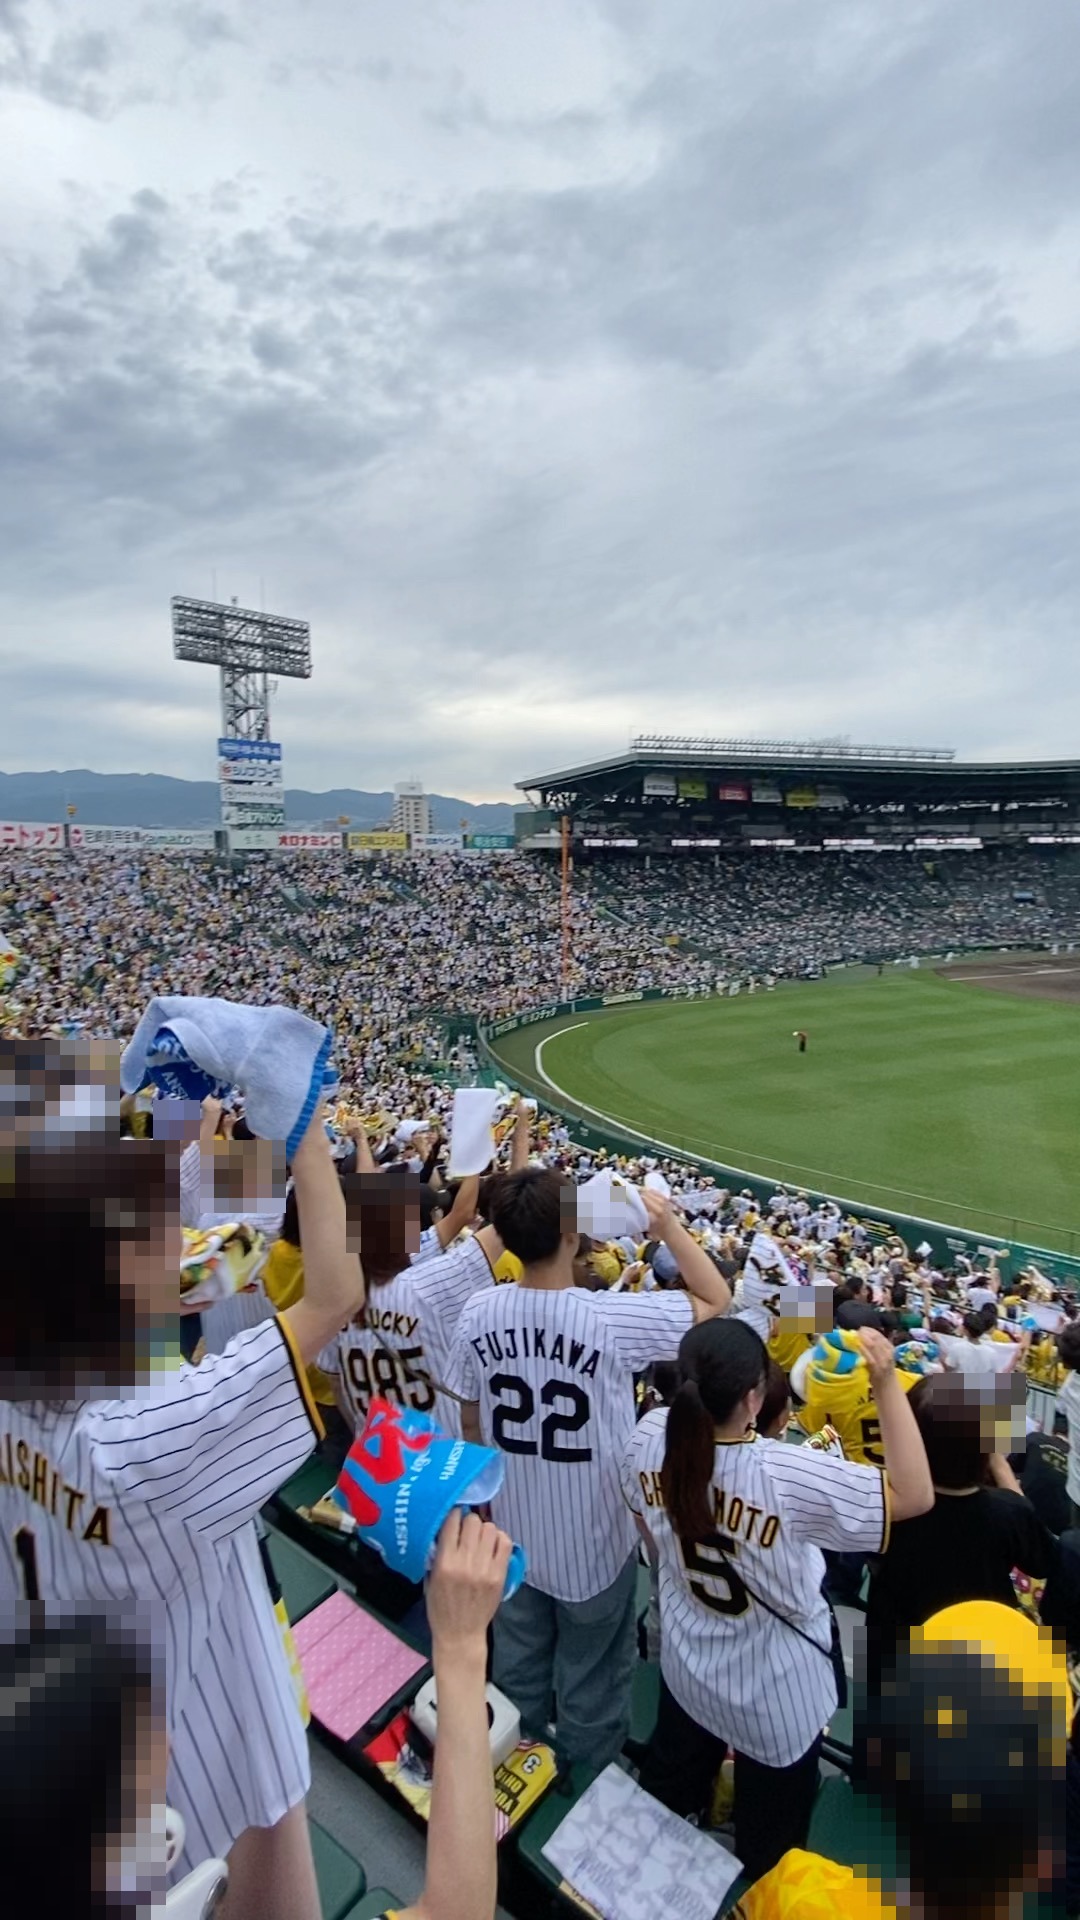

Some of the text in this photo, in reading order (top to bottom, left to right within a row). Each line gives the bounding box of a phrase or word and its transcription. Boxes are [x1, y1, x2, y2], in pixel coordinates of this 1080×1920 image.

[278, 835, 341, 847] オロナミンC
[470, 1327, 601, 1379] FUJIKAWA
[488, 1372, 593, 1463] 22
[0, 1433, 112, 1546] ISHITA
[679, 1533, 750, 1616] 5
